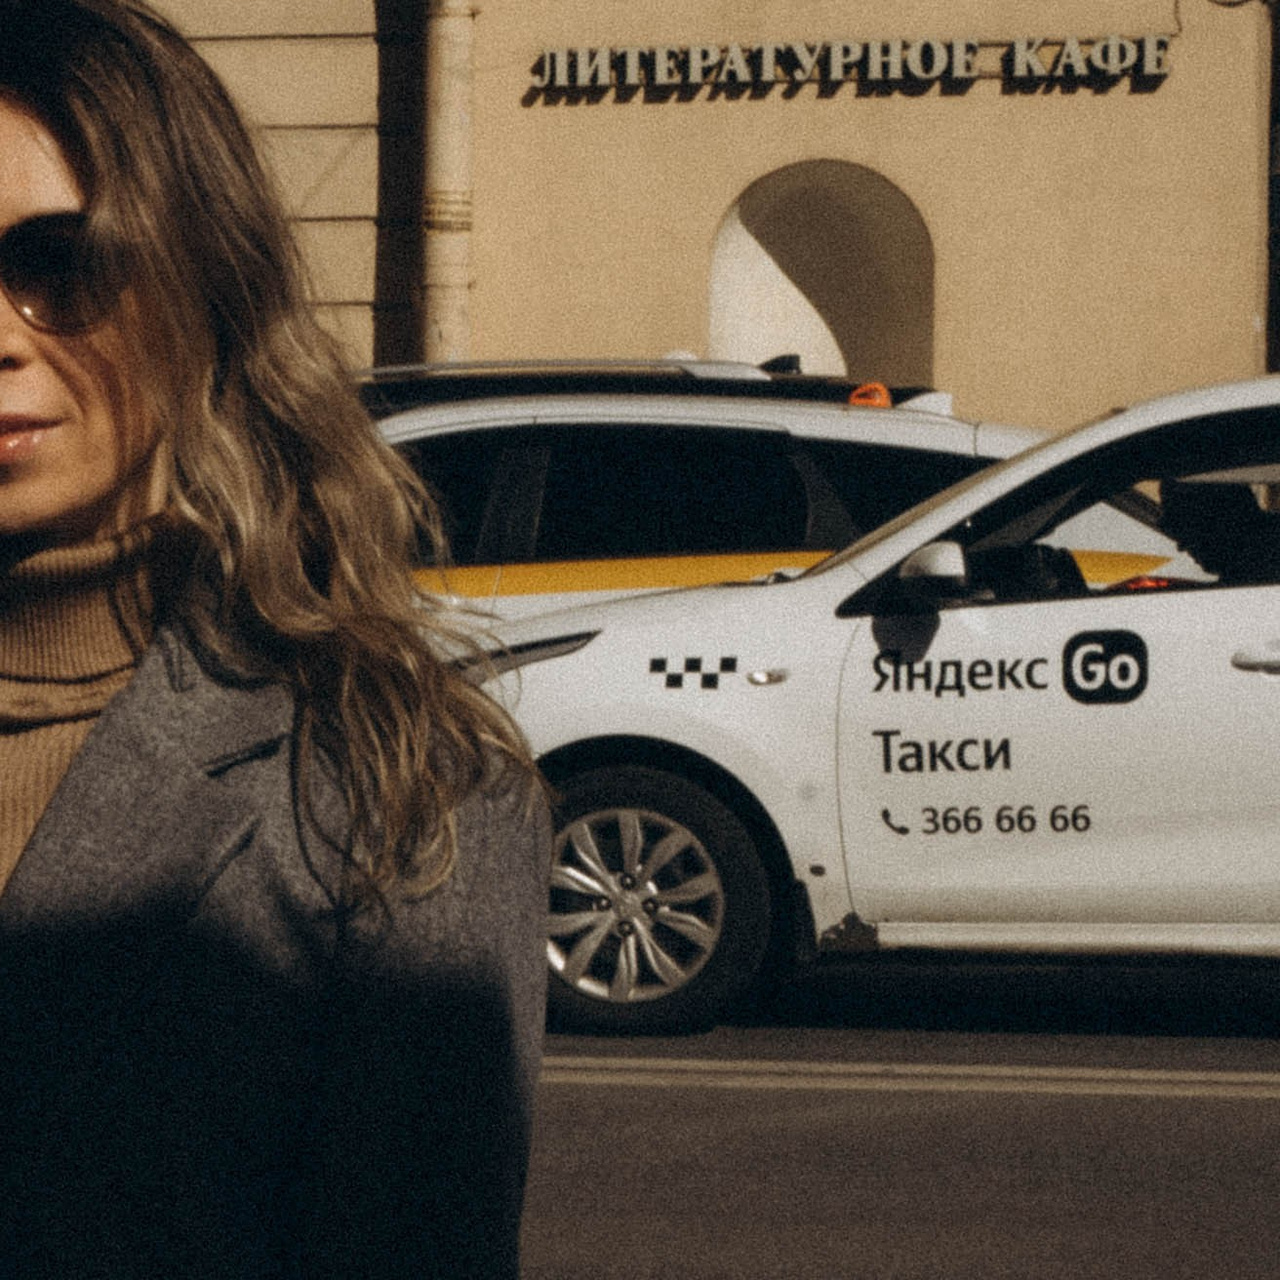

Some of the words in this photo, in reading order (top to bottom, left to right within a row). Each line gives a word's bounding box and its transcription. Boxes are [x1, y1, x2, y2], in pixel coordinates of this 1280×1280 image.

[529, 37, 979, 88] ЛИТЕРАТУРНОЕ
[1016, 33, 1172, 79] КАФЕ
[873, 648, 1049, 698] Яндекс
[1071, 642, 1140, 691] Go
[872, 730, 1012, 773] Такси
[921, 805, 983, 835] 366
[995, 805, 1037, 834] 66
[1049, 804, 1091, 833] 66
